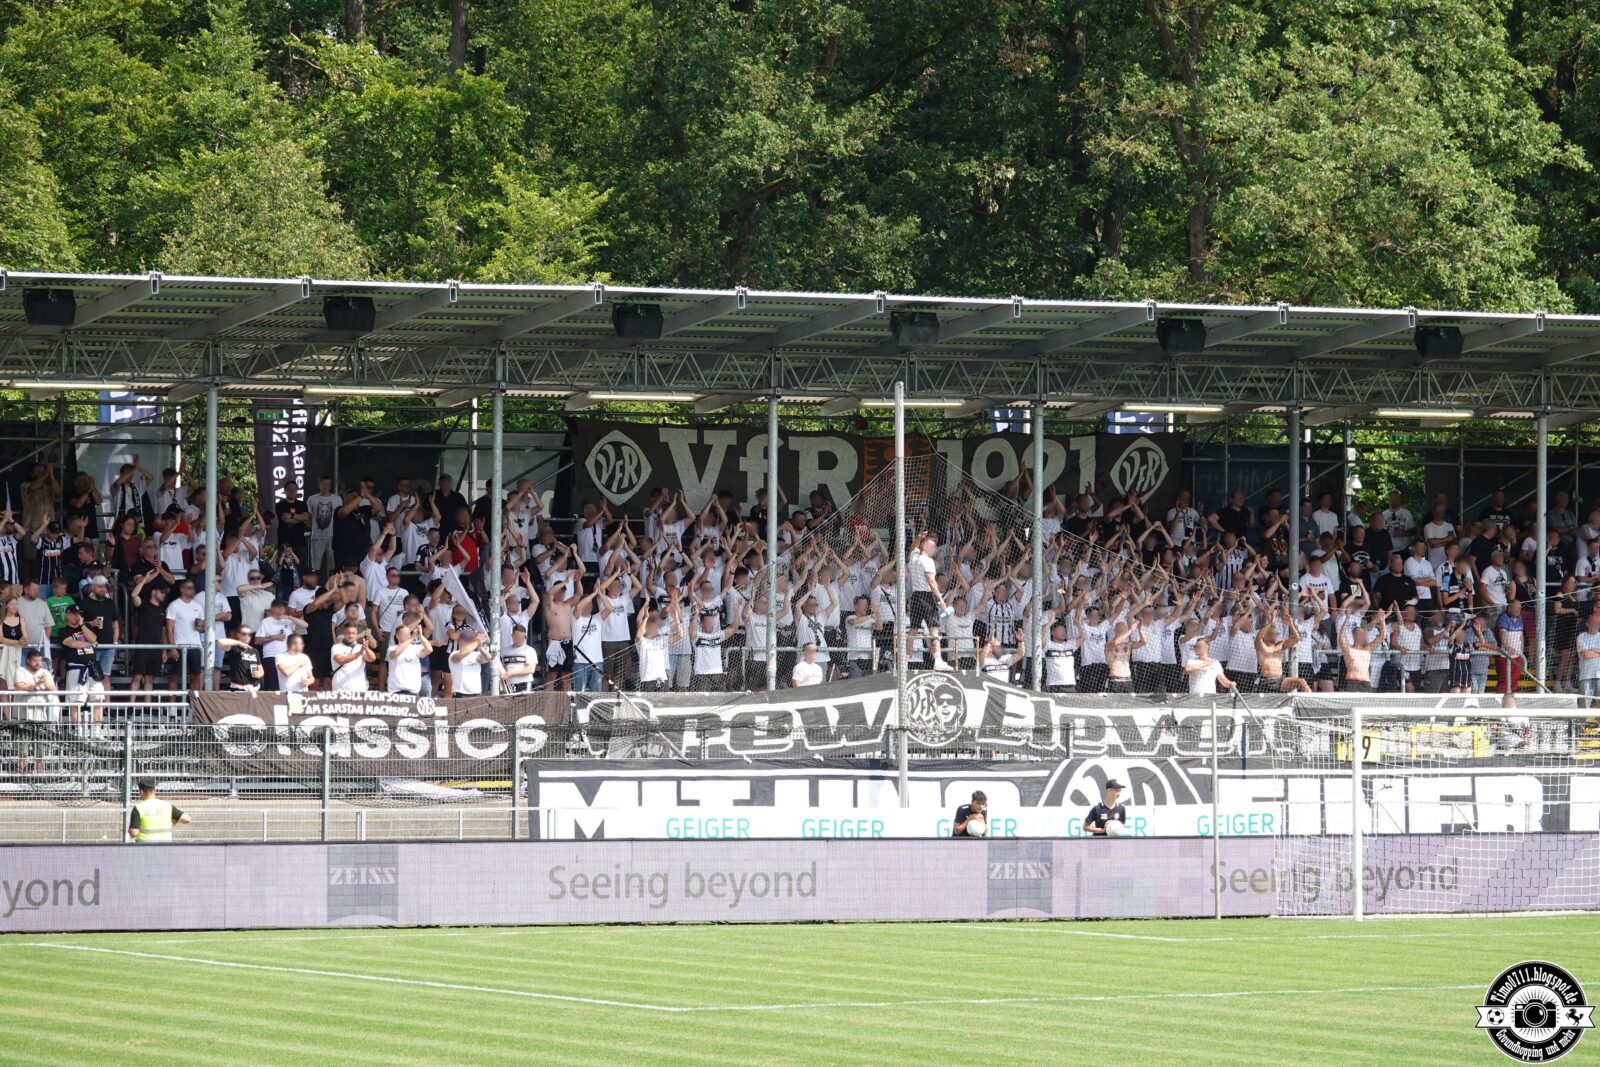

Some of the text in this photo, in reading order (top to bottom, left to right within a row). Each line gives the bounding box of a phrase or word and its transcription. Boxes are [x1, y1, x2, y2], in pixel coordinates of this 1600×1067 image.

[659, 427, 862, 520] VfR
[305, 705, 321, 715] AM
[322, 704, 364, 716] SAMSTAG
[666, 818, 750, 838] GEIGER
[802, 818, 884, 838] GEIGER
[936, 818, 1017, 838] GER
[1067, 817, 1147, 837] GER
[1197, 813, 1275, 836] GEIGER
[329, 867, 396, 885] ZEISS
[989, 861, 1051, 880] ZEISS
[1209, 857, 1459, 902] Seeing beyond
[548, 861, 817, 909] Seeing beyond
